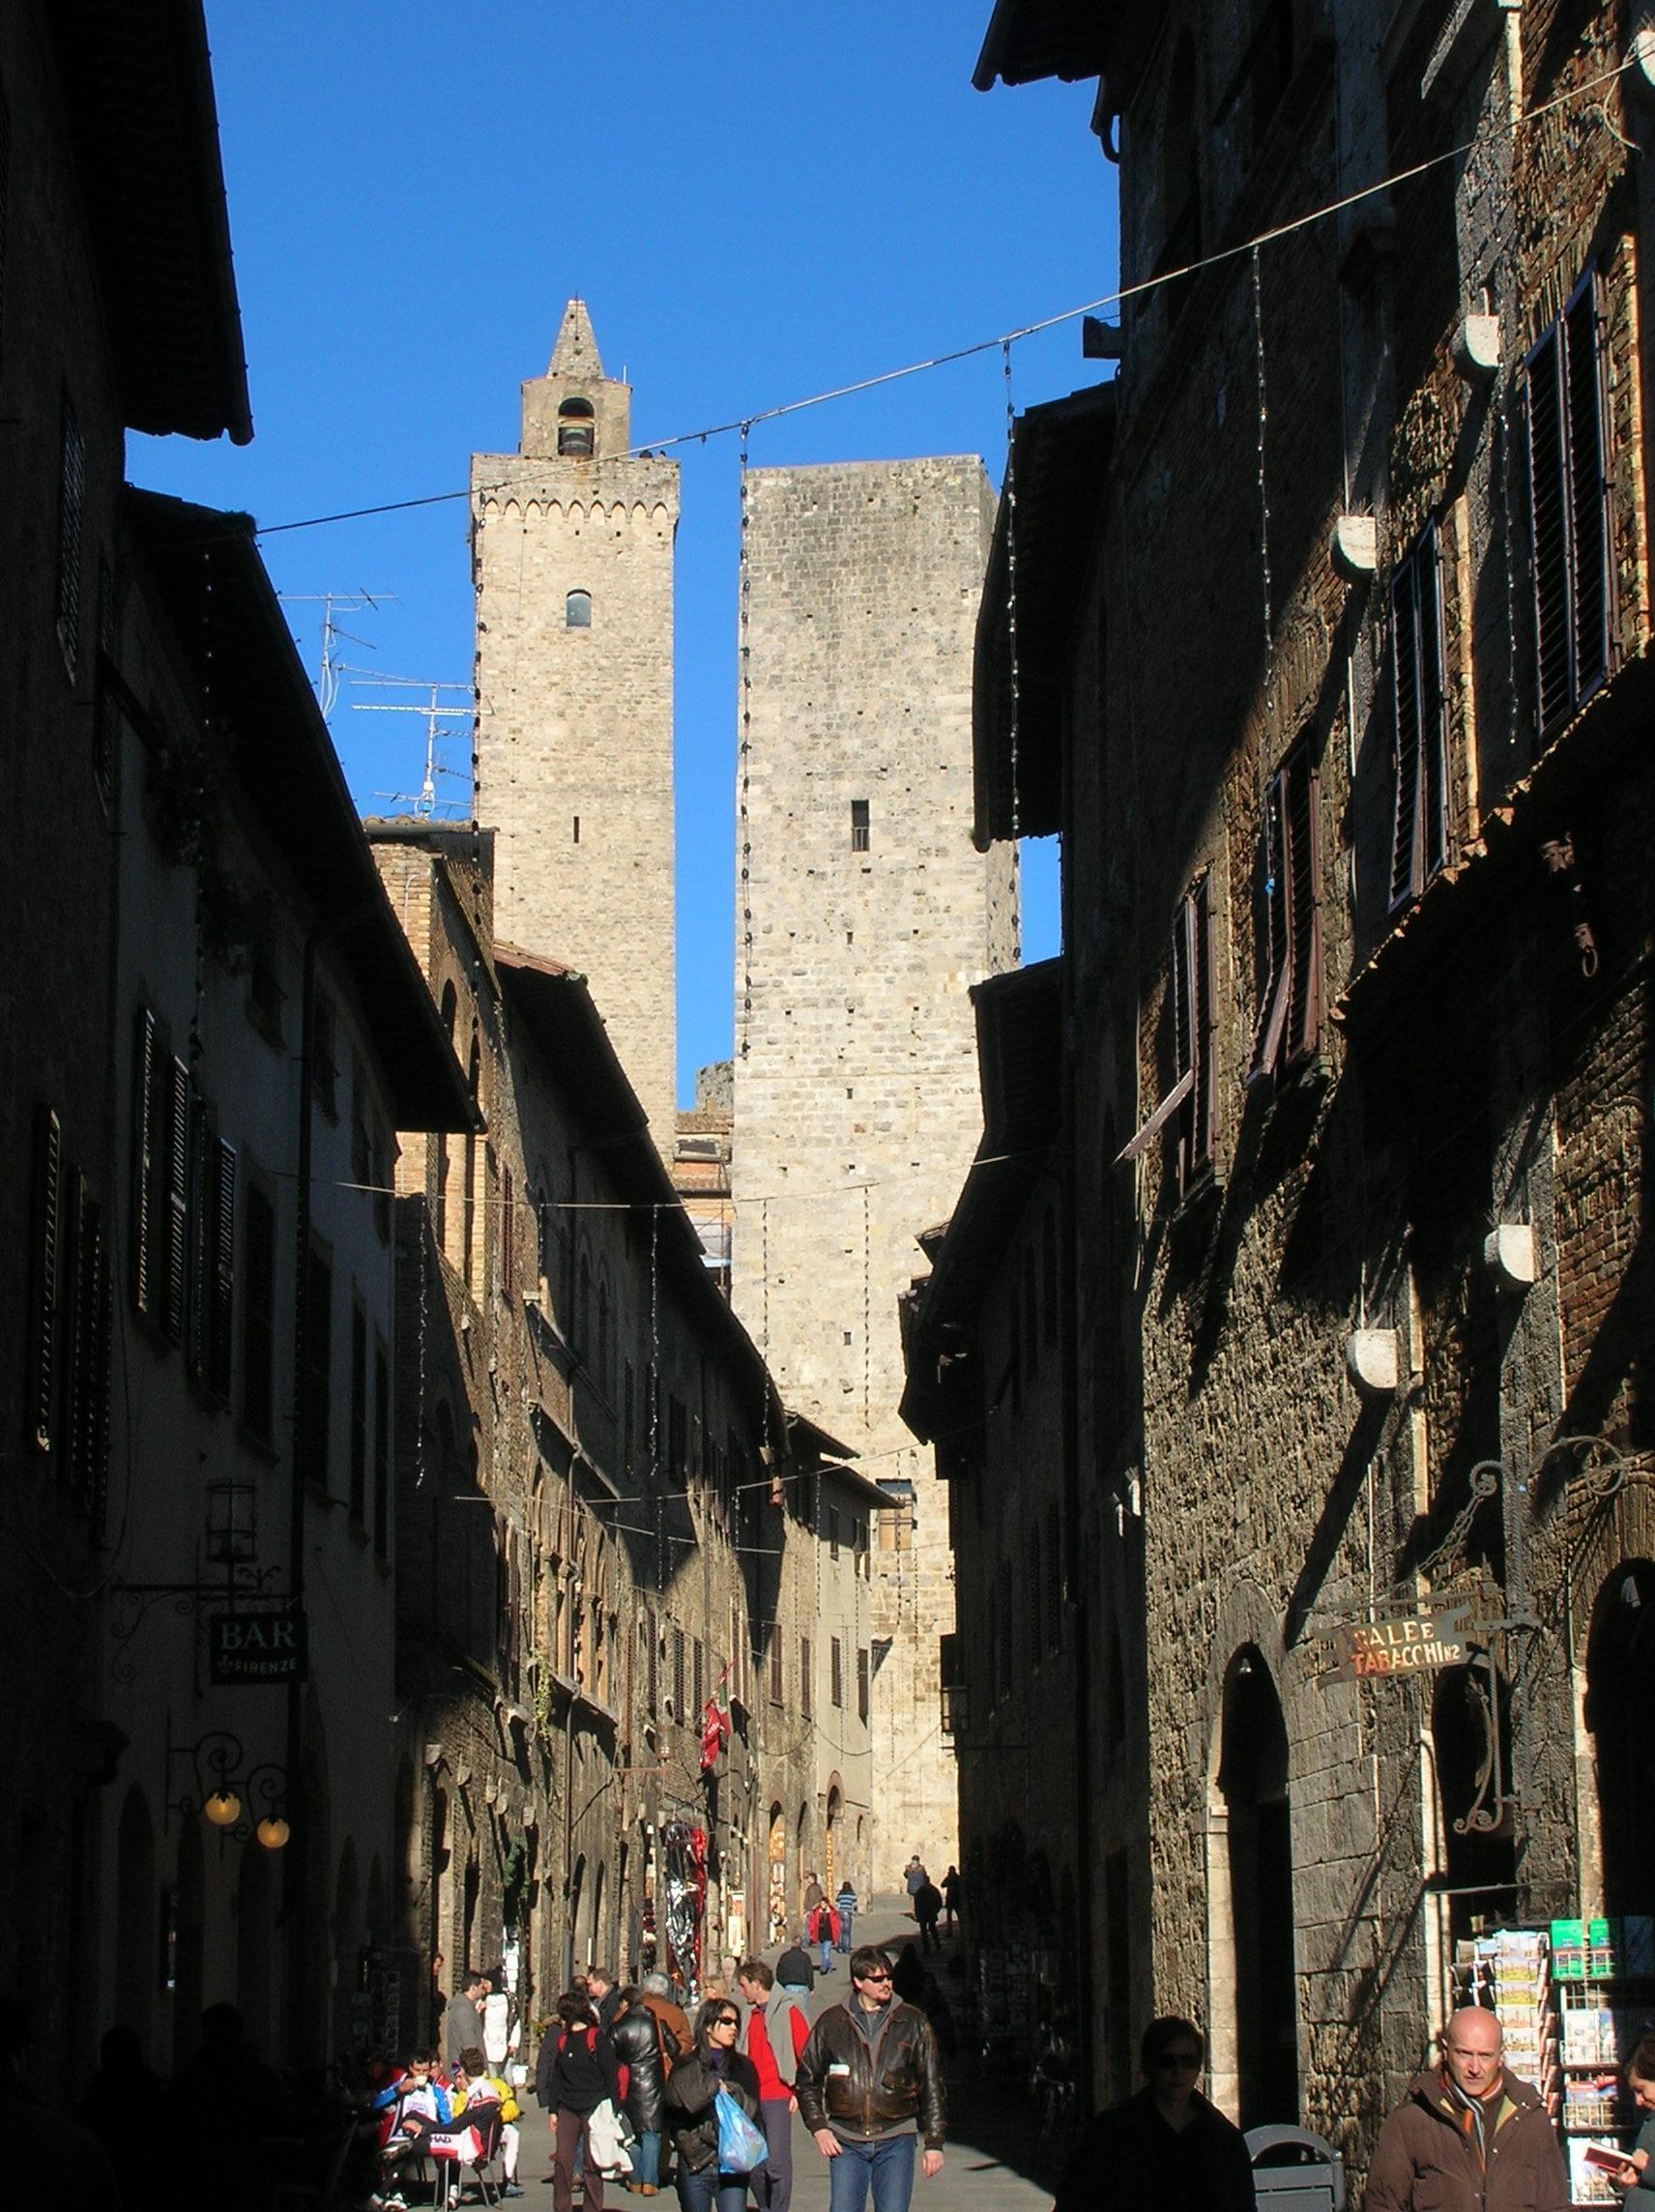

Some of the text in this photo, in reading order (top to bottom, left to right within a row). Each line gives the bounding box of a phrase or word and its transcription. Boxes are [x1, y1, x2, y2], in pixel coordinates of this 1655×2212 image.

[220, 1621, 295, 1649] BAR
[234, 1657, 297, 1674] FIRENZE
[1350, 1641, 1443, 1675] TABACCHI
